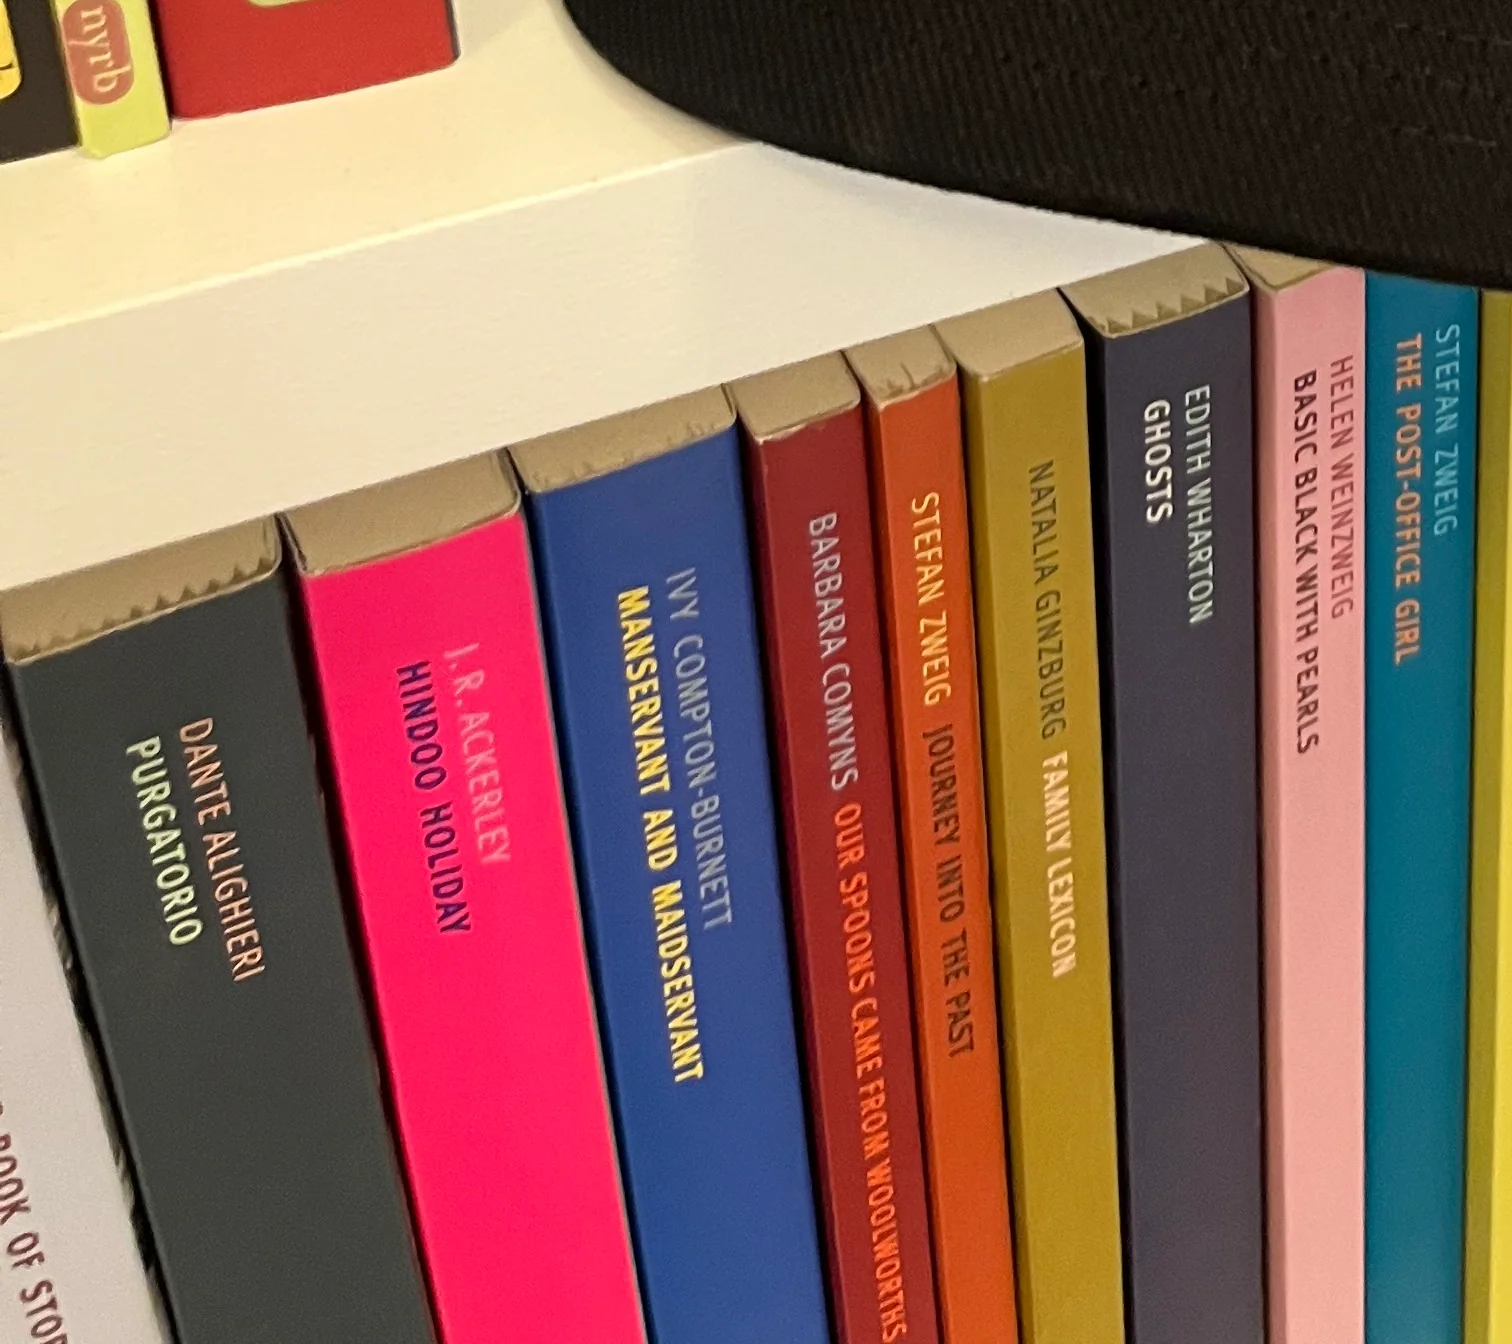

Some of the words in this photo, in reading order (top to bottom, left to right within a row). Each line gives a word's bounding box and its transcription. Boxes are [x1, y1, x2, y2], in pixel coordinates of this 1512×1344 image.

[67, 5, 130, 94] nyrb
[1293, 369, 1318, 464] BASIC
[1329, 355, 1354, 449] HELEN
[1395, 334, 1423, 391] THE
[1434, 324, 1460, 433] STEFAN
[1143, 398, 1173, 524] GHOSTS
[1184, 384, 1212, 472] EDITH
[1029, 459, 1058, 584] NATALIA
[1293, 468, 1318, 563] BLACK
[1329, 452, 1354, 619] WEINZWEIG
[1394, 403, 1422, 588] POST-OFFICE
[1433, 444, 1458, 536] ZWEIG
[665, 567, 698, 622] IVY
[809, 512, 847, 659] BARBARA
[911, 491, 945, 603] STEFAN
[1184, 473, 1214, 625] WHARTON
[1294, 564, 1320, 641] WITH
[1394, 598, 1421, 665] GIRL
[617, 585, 672, 799] MANSERVANT
[918, 610, 951, 706] ZWEIG
[1035, 589, 1066, 741] GINZBURG
[1295, 646, 1320, 755] PEARLS
[180, 717, 231, 826] DANTE
[397, 660, 447, 790] HINDOO
[820, 665, 858, 791] COMYNS
[459, 711, 511, 864] ACKERLEY
[672, 635, 733, 932] COMPTON-BURNETT
[833, 803, 867, 867] OUR
[922, 723, 958, 847] JOURNEY
[1042, 750, 1070, 854] FAMILY
[127, 736, 203, 946] PURGATORIO
[419, 801, 472, 935] HOLIDAY
[642, 810, 679, 873] AND
[934, 852, 965, 925] INTO
[205, 830, 265, 981] ALIGHIERI
[838, 873, 876, 992] SPOONS
[941, 928, 968, 987] THE
[1044, 855, 1077, 979] LEXICON
[650, 879, 704, 1084] MAIDSERVANT
[947, 988, 974, 1057] PAST
[849, 997, 883, 1078] CAME
[860, 1078, 891, 1160] FROM
[6, 1231, 45, 1269] OF
[866, 1157, 907, 1343] WOOLWORTHS
